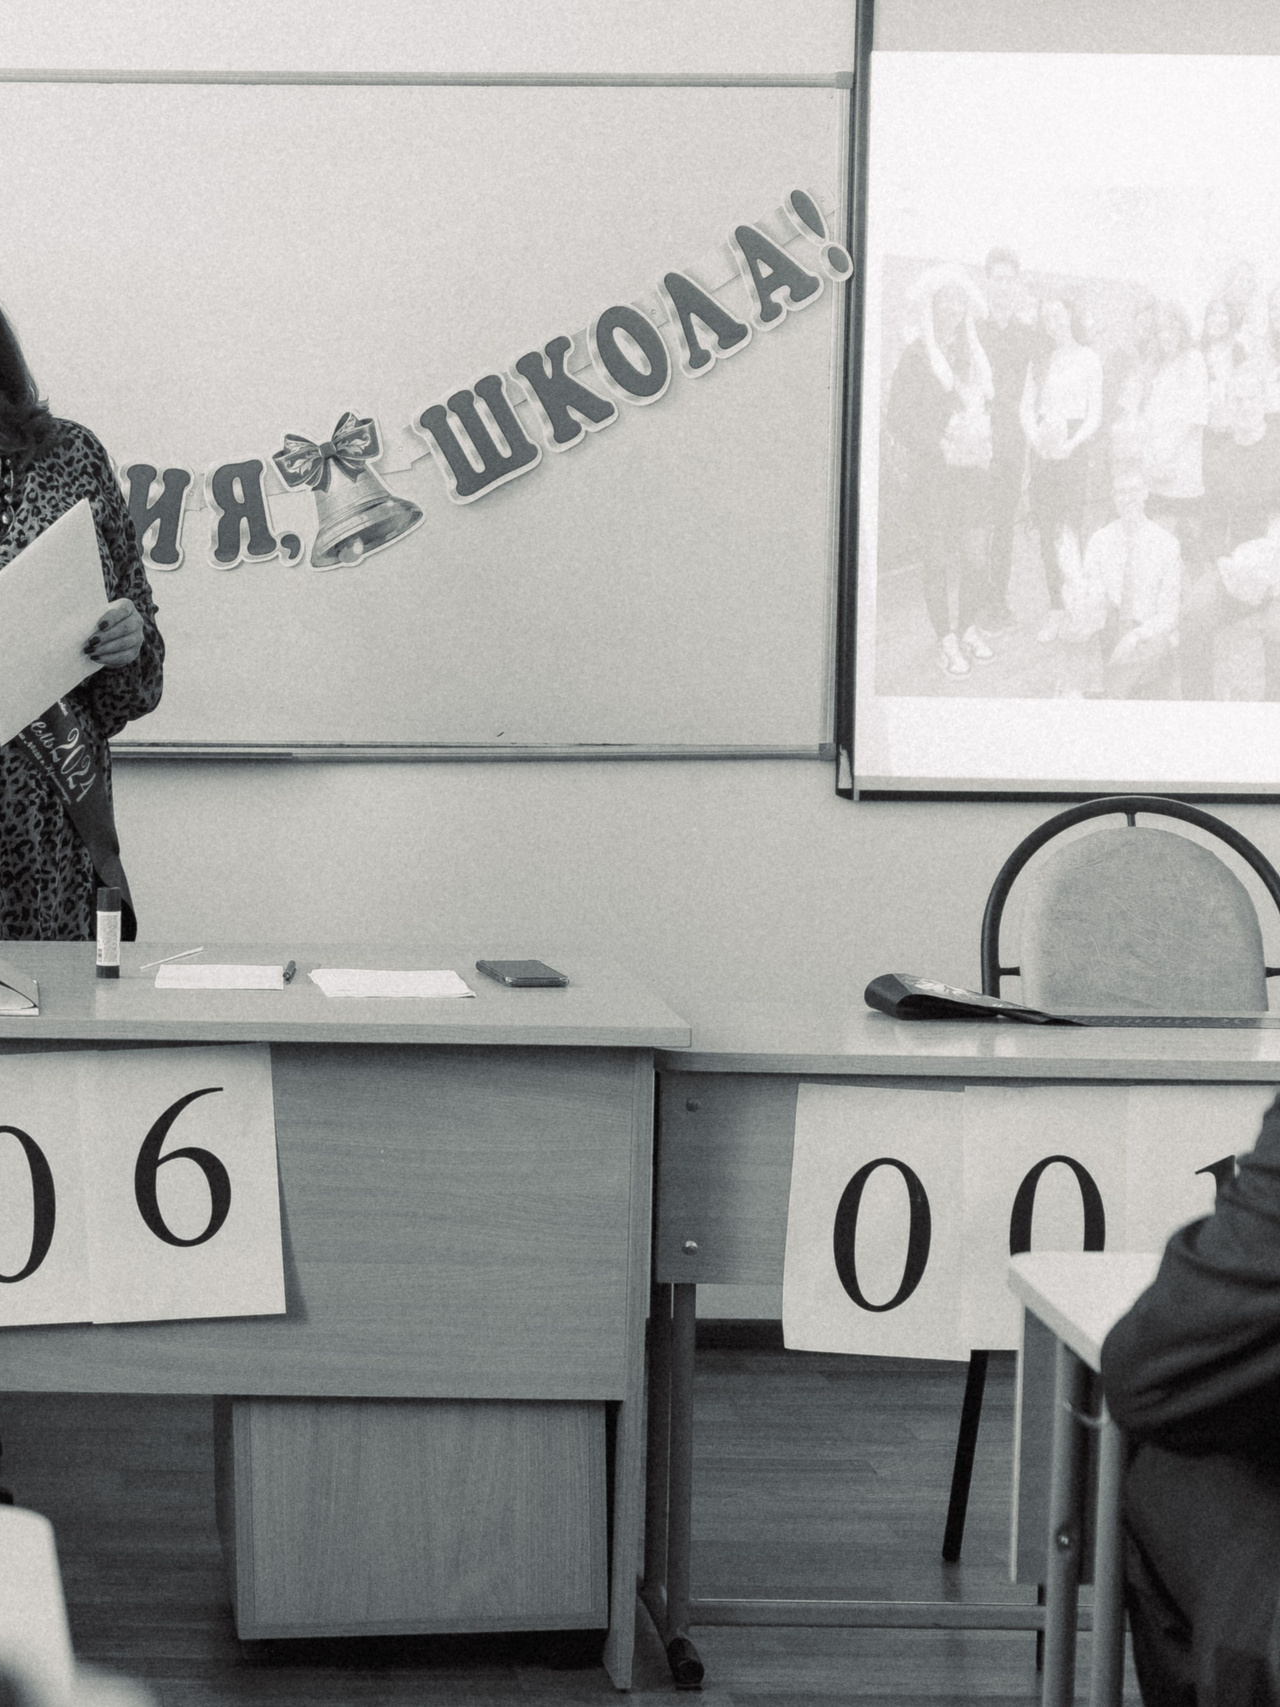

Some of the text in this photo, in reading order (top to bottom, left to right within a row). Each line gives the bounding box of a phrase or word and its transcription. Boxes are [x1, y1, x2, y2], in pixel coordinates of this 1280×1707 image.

[419, 189, 850, 497] ШКОЛА!
[48, 727, 96, 802] 2024
[833, 1155, 1236, 1313] 00
